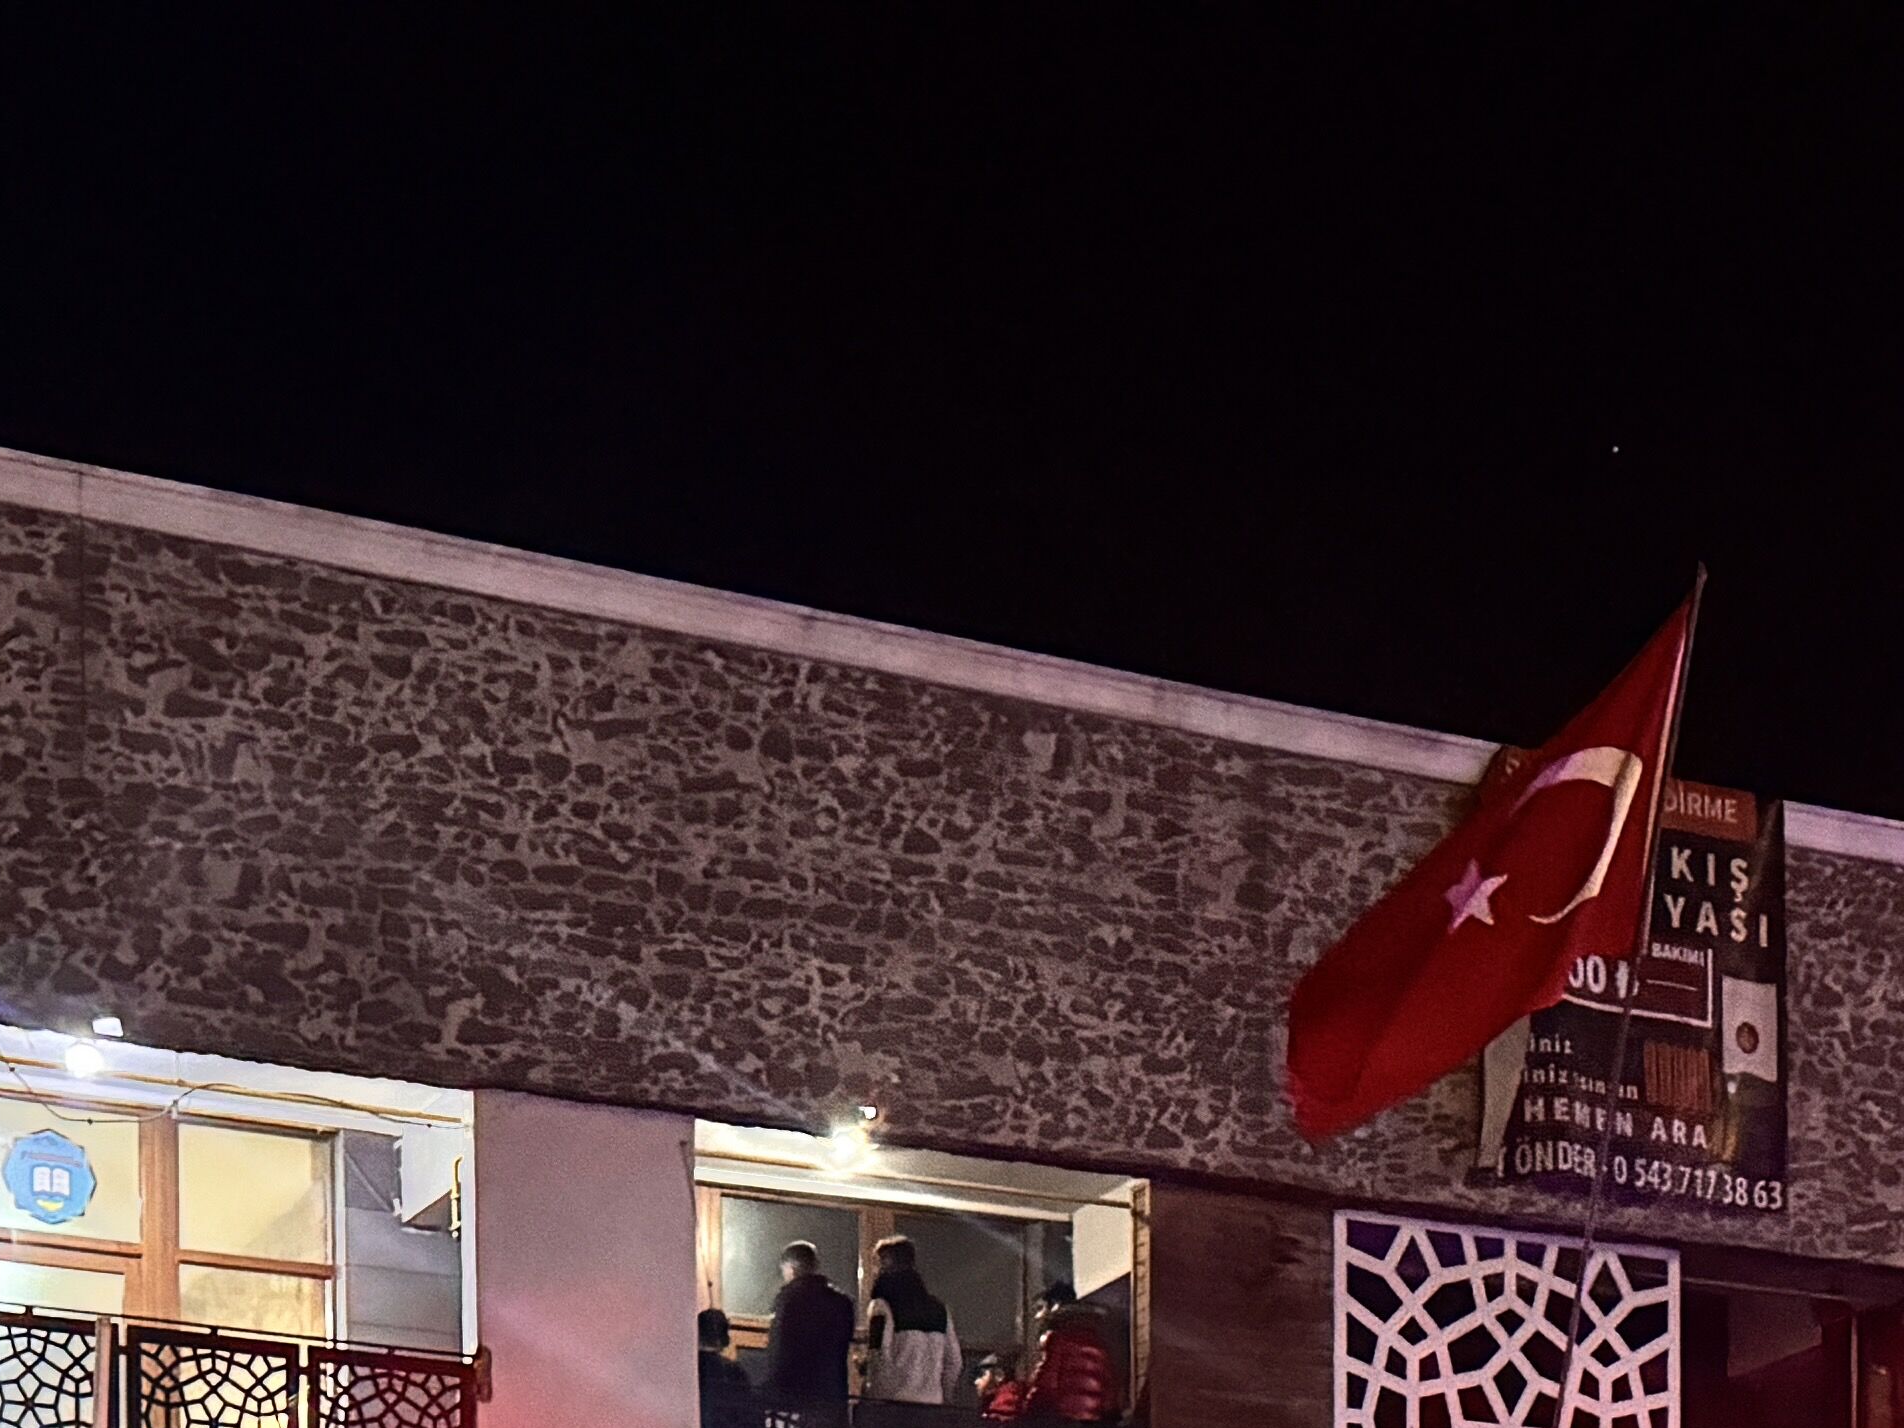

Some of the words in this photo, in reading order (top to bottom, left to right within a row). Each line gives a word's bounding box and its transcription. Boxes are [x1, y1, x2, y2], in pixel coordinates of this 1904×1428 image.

[1670, 846, 1749, 903] KIŞ
[1524, 1096, 1634, 1137] HEMEN
[1651, 1117, 1708, 1150] ARA
